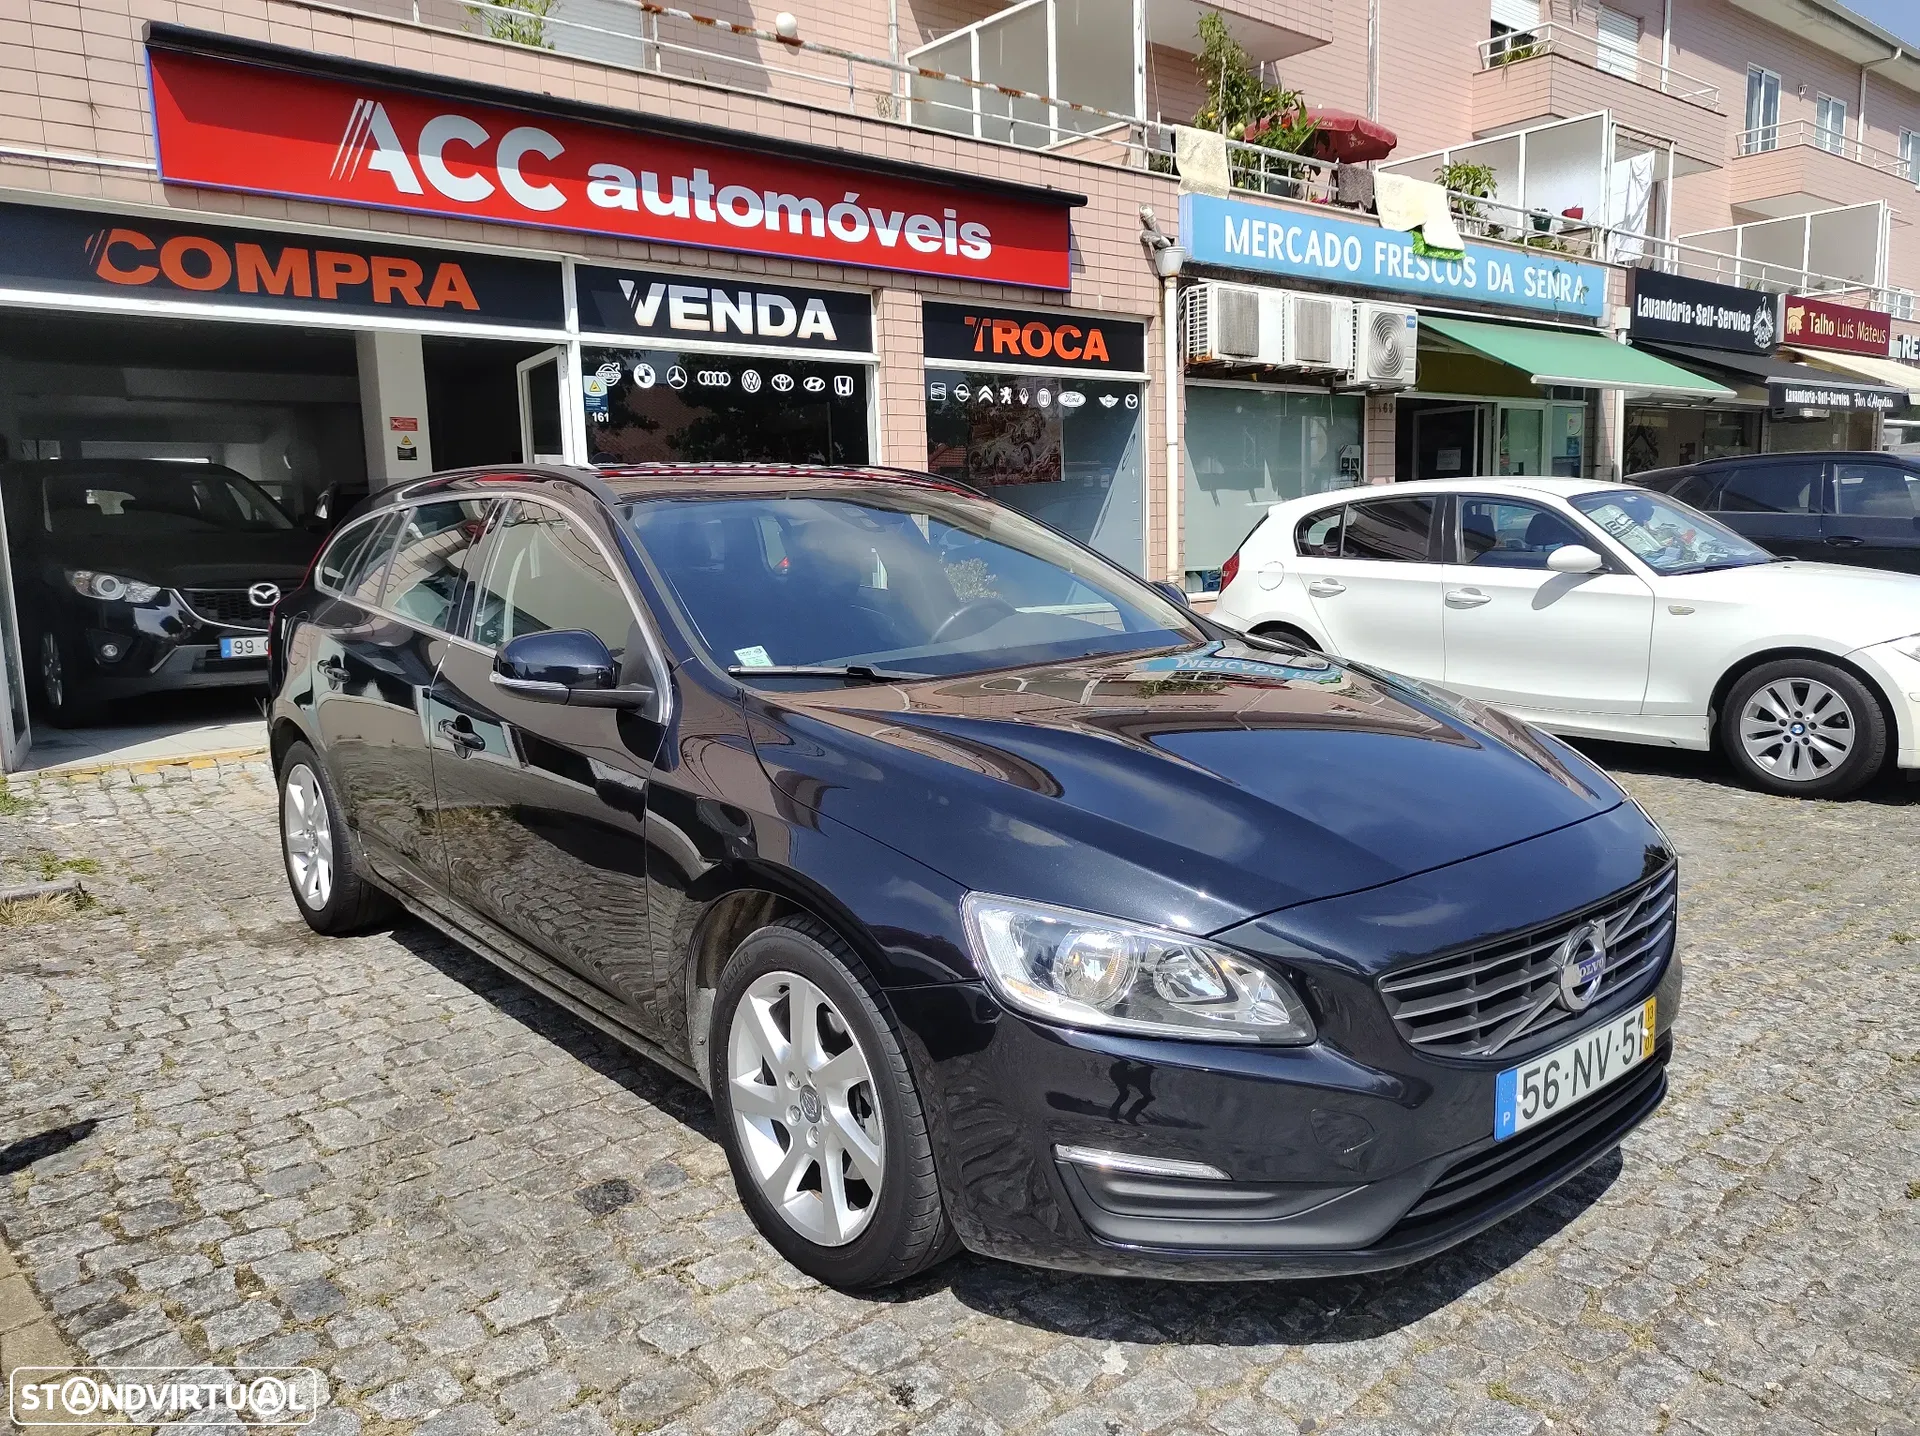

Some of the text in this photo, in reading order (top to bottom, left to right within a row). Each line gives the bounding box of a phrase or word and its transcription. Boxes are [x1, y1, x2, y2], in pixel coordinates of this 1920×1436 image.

[328, 98, 992, 260] ACC automóveis
[83, 228, 481, 311] COMPRA
[1224, 215, 1586, 305] MERCADO FRESCOS DA SENRA
[618, 279, 838, 341] VENDA
[1809, 311, 1886, 345] Talho Luís Mateus
[964, 315, 1111, 363] TROCA
[1902, 334, 1920, 360] RE
[592, 412, 609, 422] 161
[1646, 1003, 1655, 1021] 13
[1503, 1111, 1511, 1126] P
